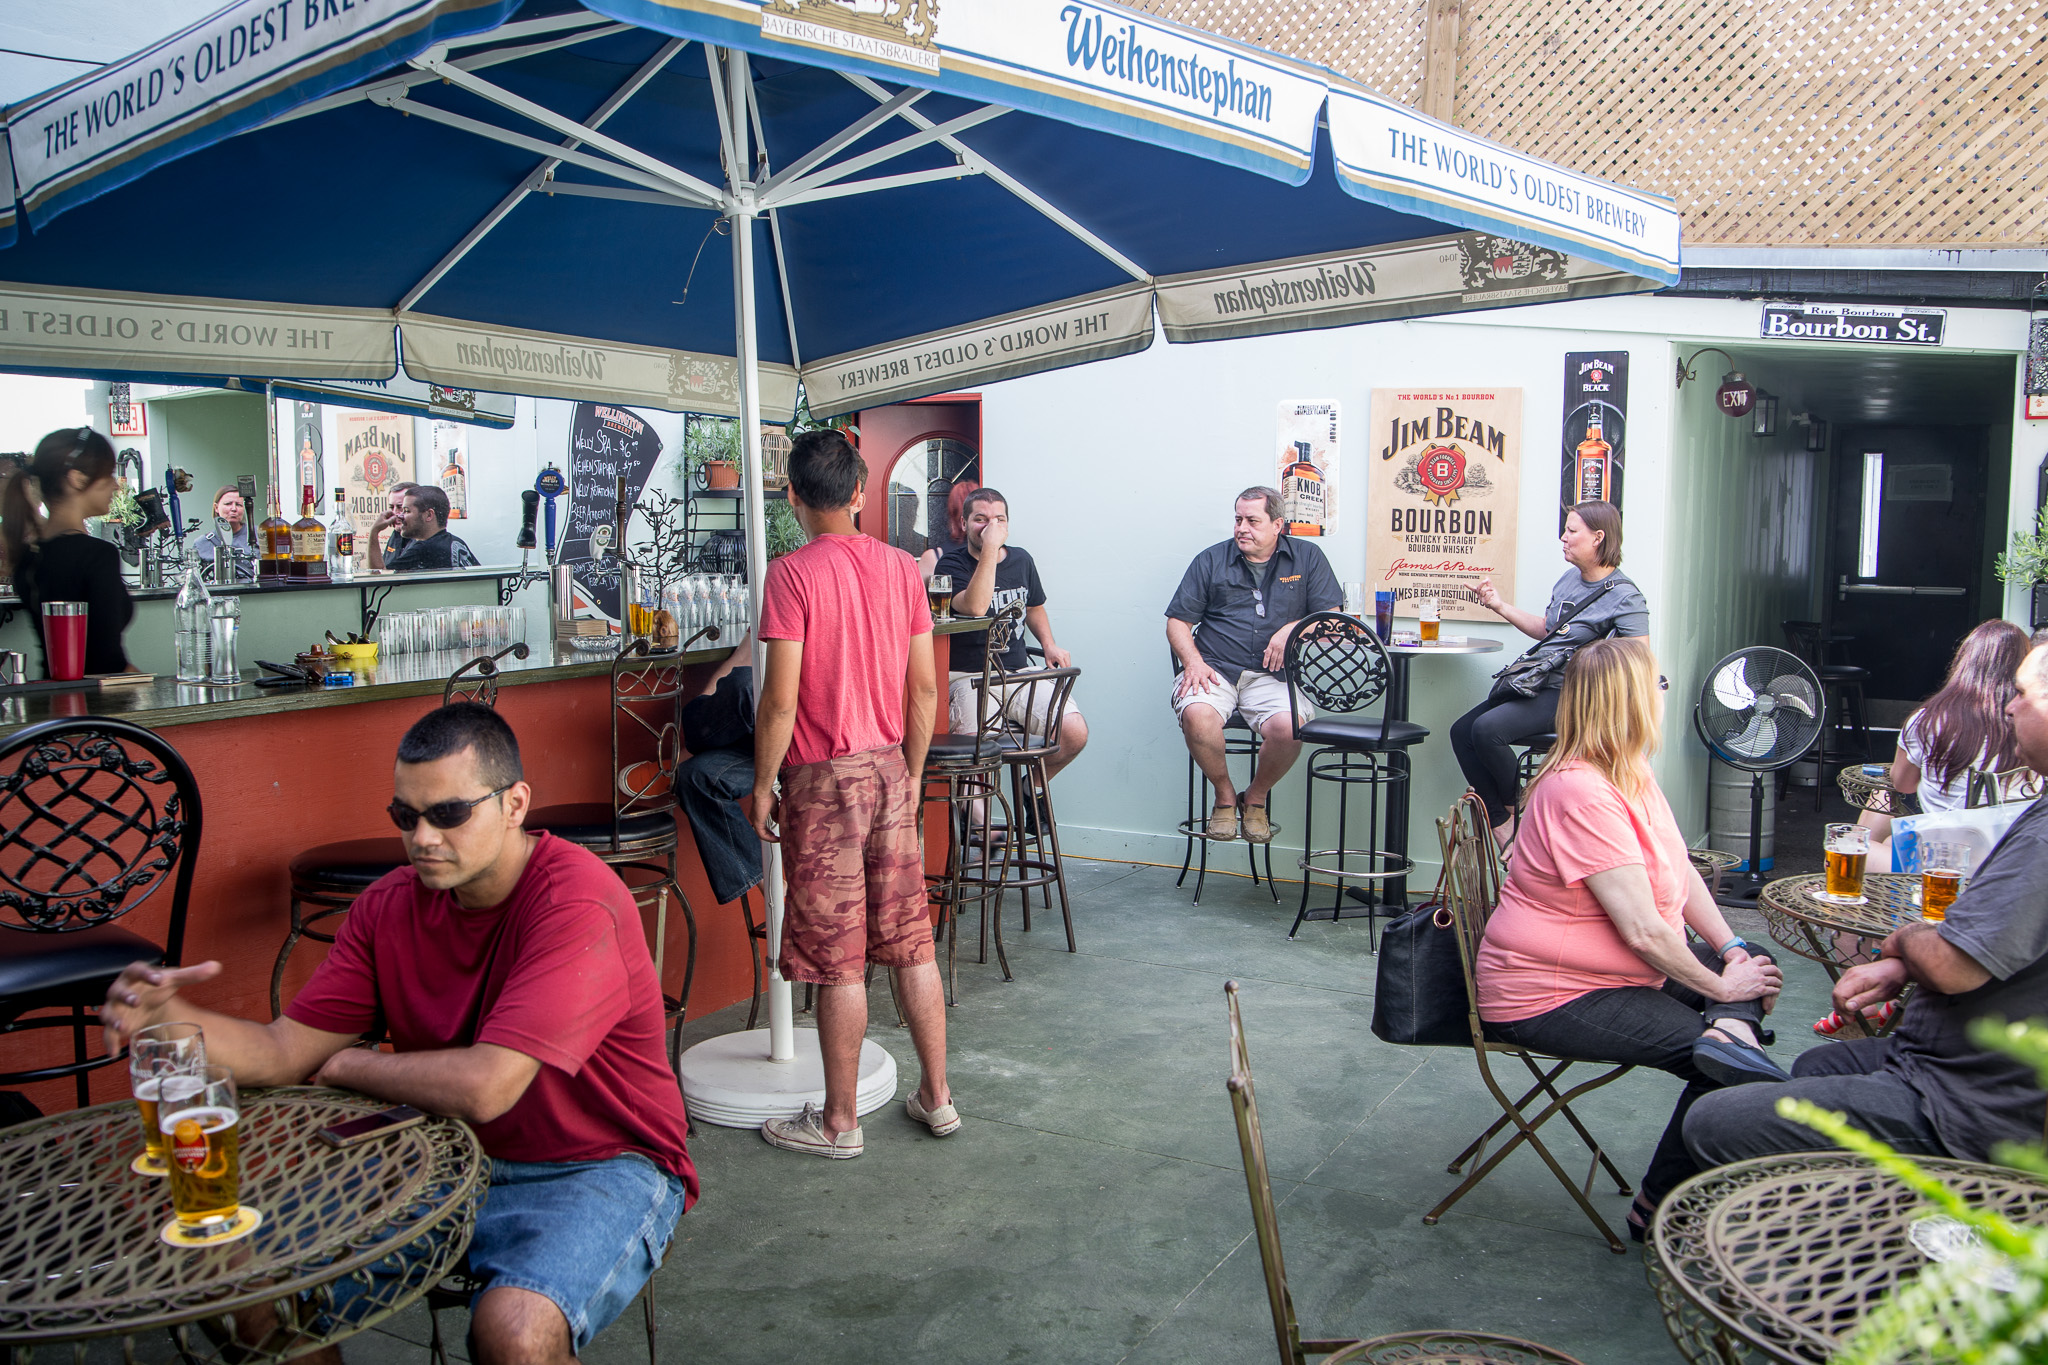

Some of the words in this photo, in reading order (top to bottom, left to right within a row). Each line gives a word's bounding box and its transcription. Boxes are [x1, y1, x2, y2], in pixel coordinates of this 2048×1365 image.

[762, 15, 839, 45] BAYERISCHE
[1060, 5, 1272, 123] Weihenstephan
[43, 110, 79, 159] THE
[193, 0, 293, 84] OLDEST
[1388, 127, 1428, 167] THE
[1433, 142, 1519, 195] WORLD'S
[1524, 175, 1583, 217] OLDEST
[1587, 199, 1647, 239] BREWERY
[1810, 307, 1835, 315] Rue
[1841, 308, 1895, 317] Bourbon
[1768, 314, 1888, 339] Bourbon
[1896, 318, 1936, 341] St.
[1579, 362, 1593, 375] JIM
[1593, 359, 1614, 374] BEAM
[1582, 383, 1610, 392] BLACK
[1722, 390, 1749, 408] EXIT
[595, 406, 644, 435] WELLINGTON
[1329, 410, 1337, 421] 100
[606, 420, 631, 435] BREWERY
[1329, 423, 1337, 444] PROOF
[1382, 416, 1431, 462] JIM
[1435, 407, 1506, 462] BEAM
[1436, 462, 1449, 477] B
[1297, 477, 1321, 496] KNOB
[1299, 493, 1324, 504] CREEK
[1391, 508, 1492, 535] BOURBON
[1405, 534, 1442, 544] KENTUCKY
[1443, 535, 1477, 545] STRAIGHT
[1408, 544, 1441, 553] BOURBON
[1442, 545, 1474, 554] WHISKEY
[1420, 588, 1440, 598] BEAM
[1441, 589, 1479, 604] DISTILLING
